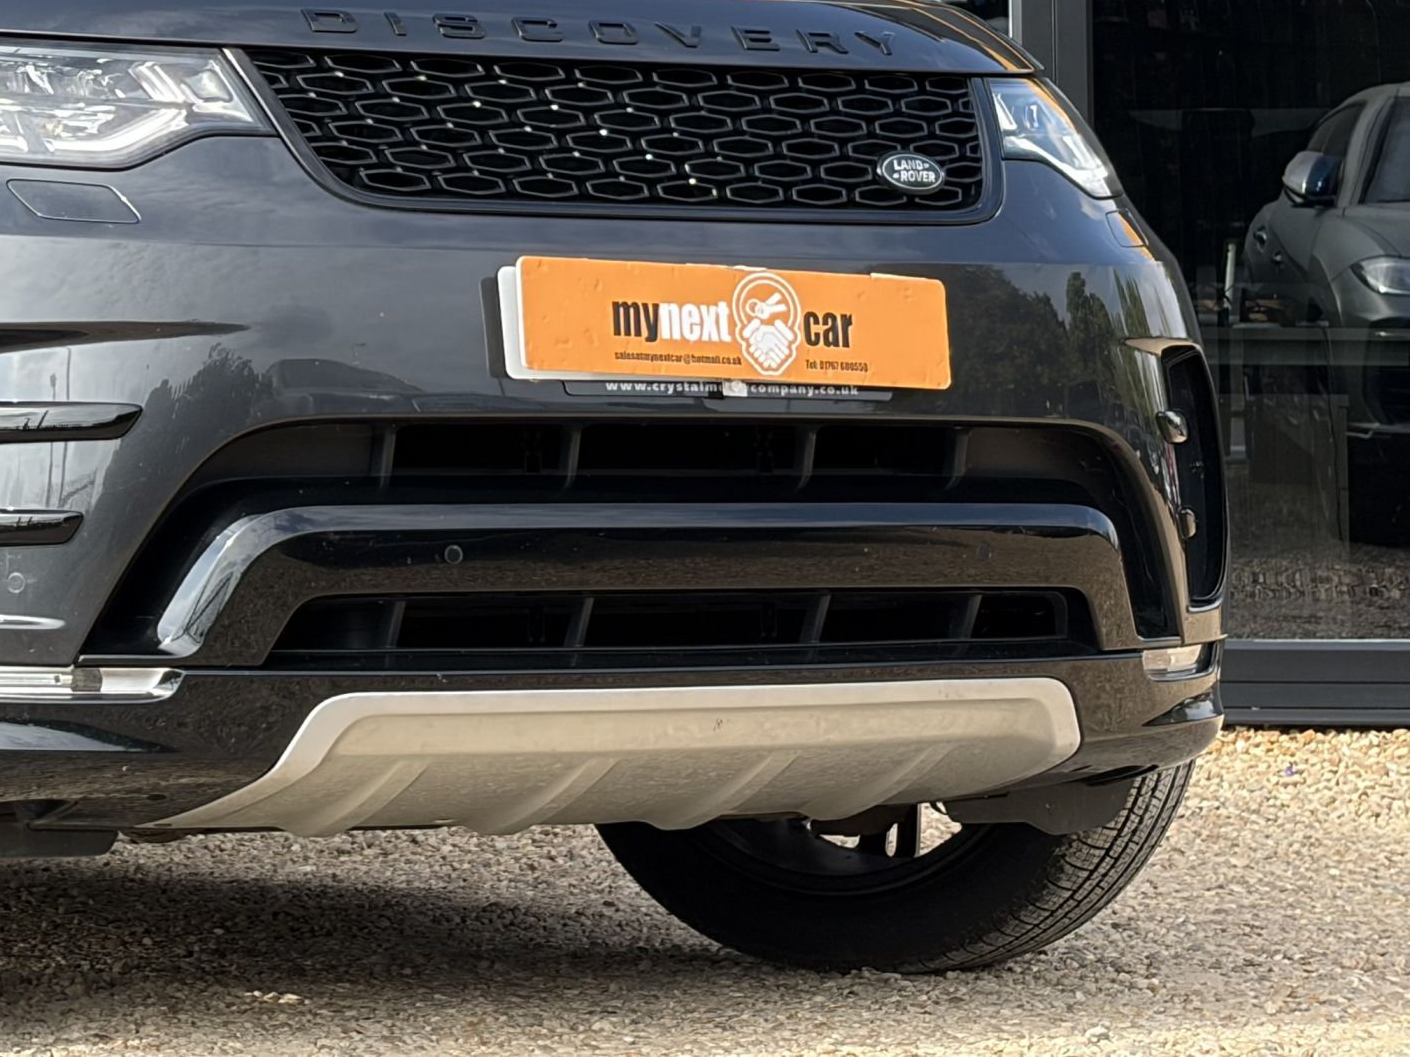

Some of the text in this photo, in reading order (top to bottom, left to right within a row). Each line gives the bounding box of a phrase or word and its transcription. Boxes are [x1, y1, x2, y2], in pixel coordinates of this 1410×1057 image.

[300, 8, 896, 56] DISCOVERY
[893, 159, 923, 171] LAND
[900, 170, 936, 183] ROVER
[803, 311, 854, 349] car
